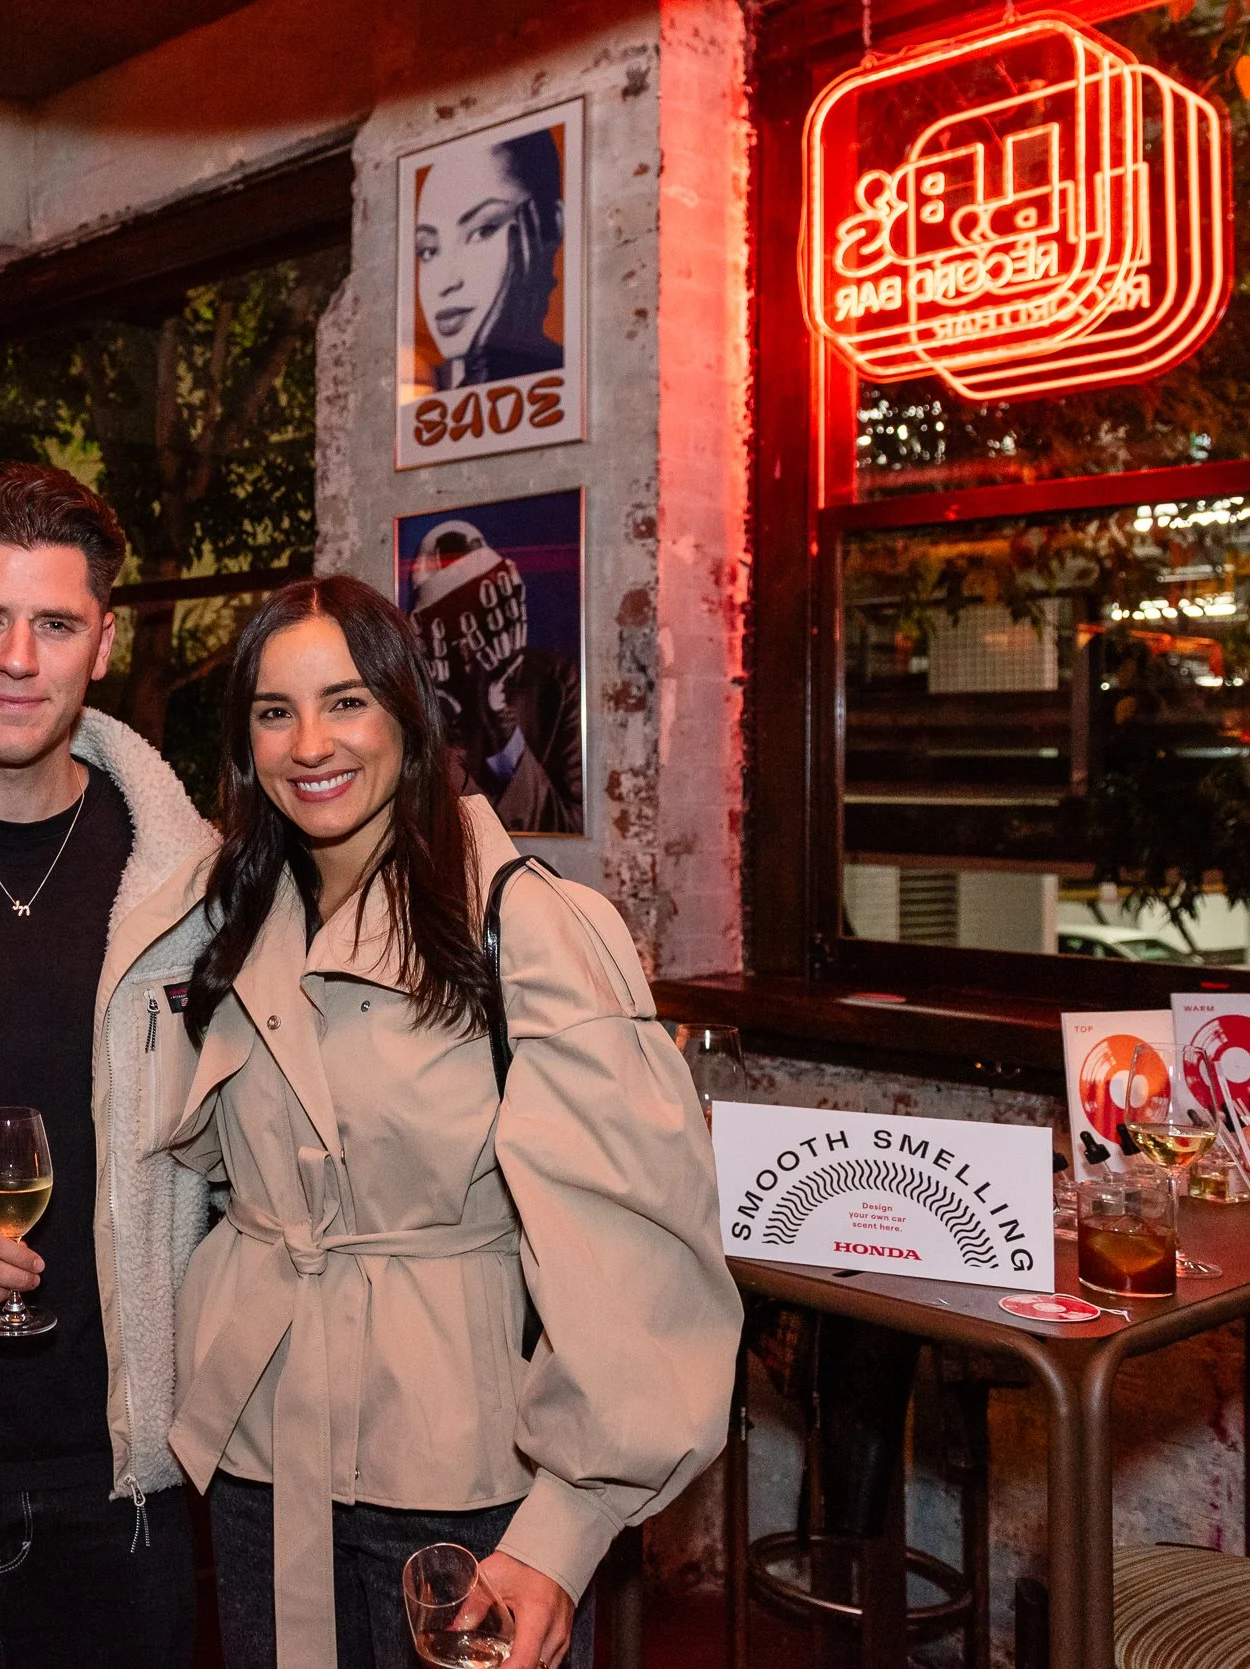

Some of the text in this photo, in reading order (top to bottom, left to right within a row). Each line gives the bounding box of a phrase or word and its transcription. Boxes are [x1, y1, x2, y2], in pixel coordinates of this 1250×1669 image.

[413, 376, 565, 447] SADE
[1074, 1025, 1094, 1033] TOP
[731, 1129, 1035, 1273] SMOOTH SMELLING
[862, 1202, 893, 1213] Design
[849, 1211, 869, 1219] your
[852, 1221, 903, 1233] scent here.
[833, 1241, 923, 1262] HONDA
